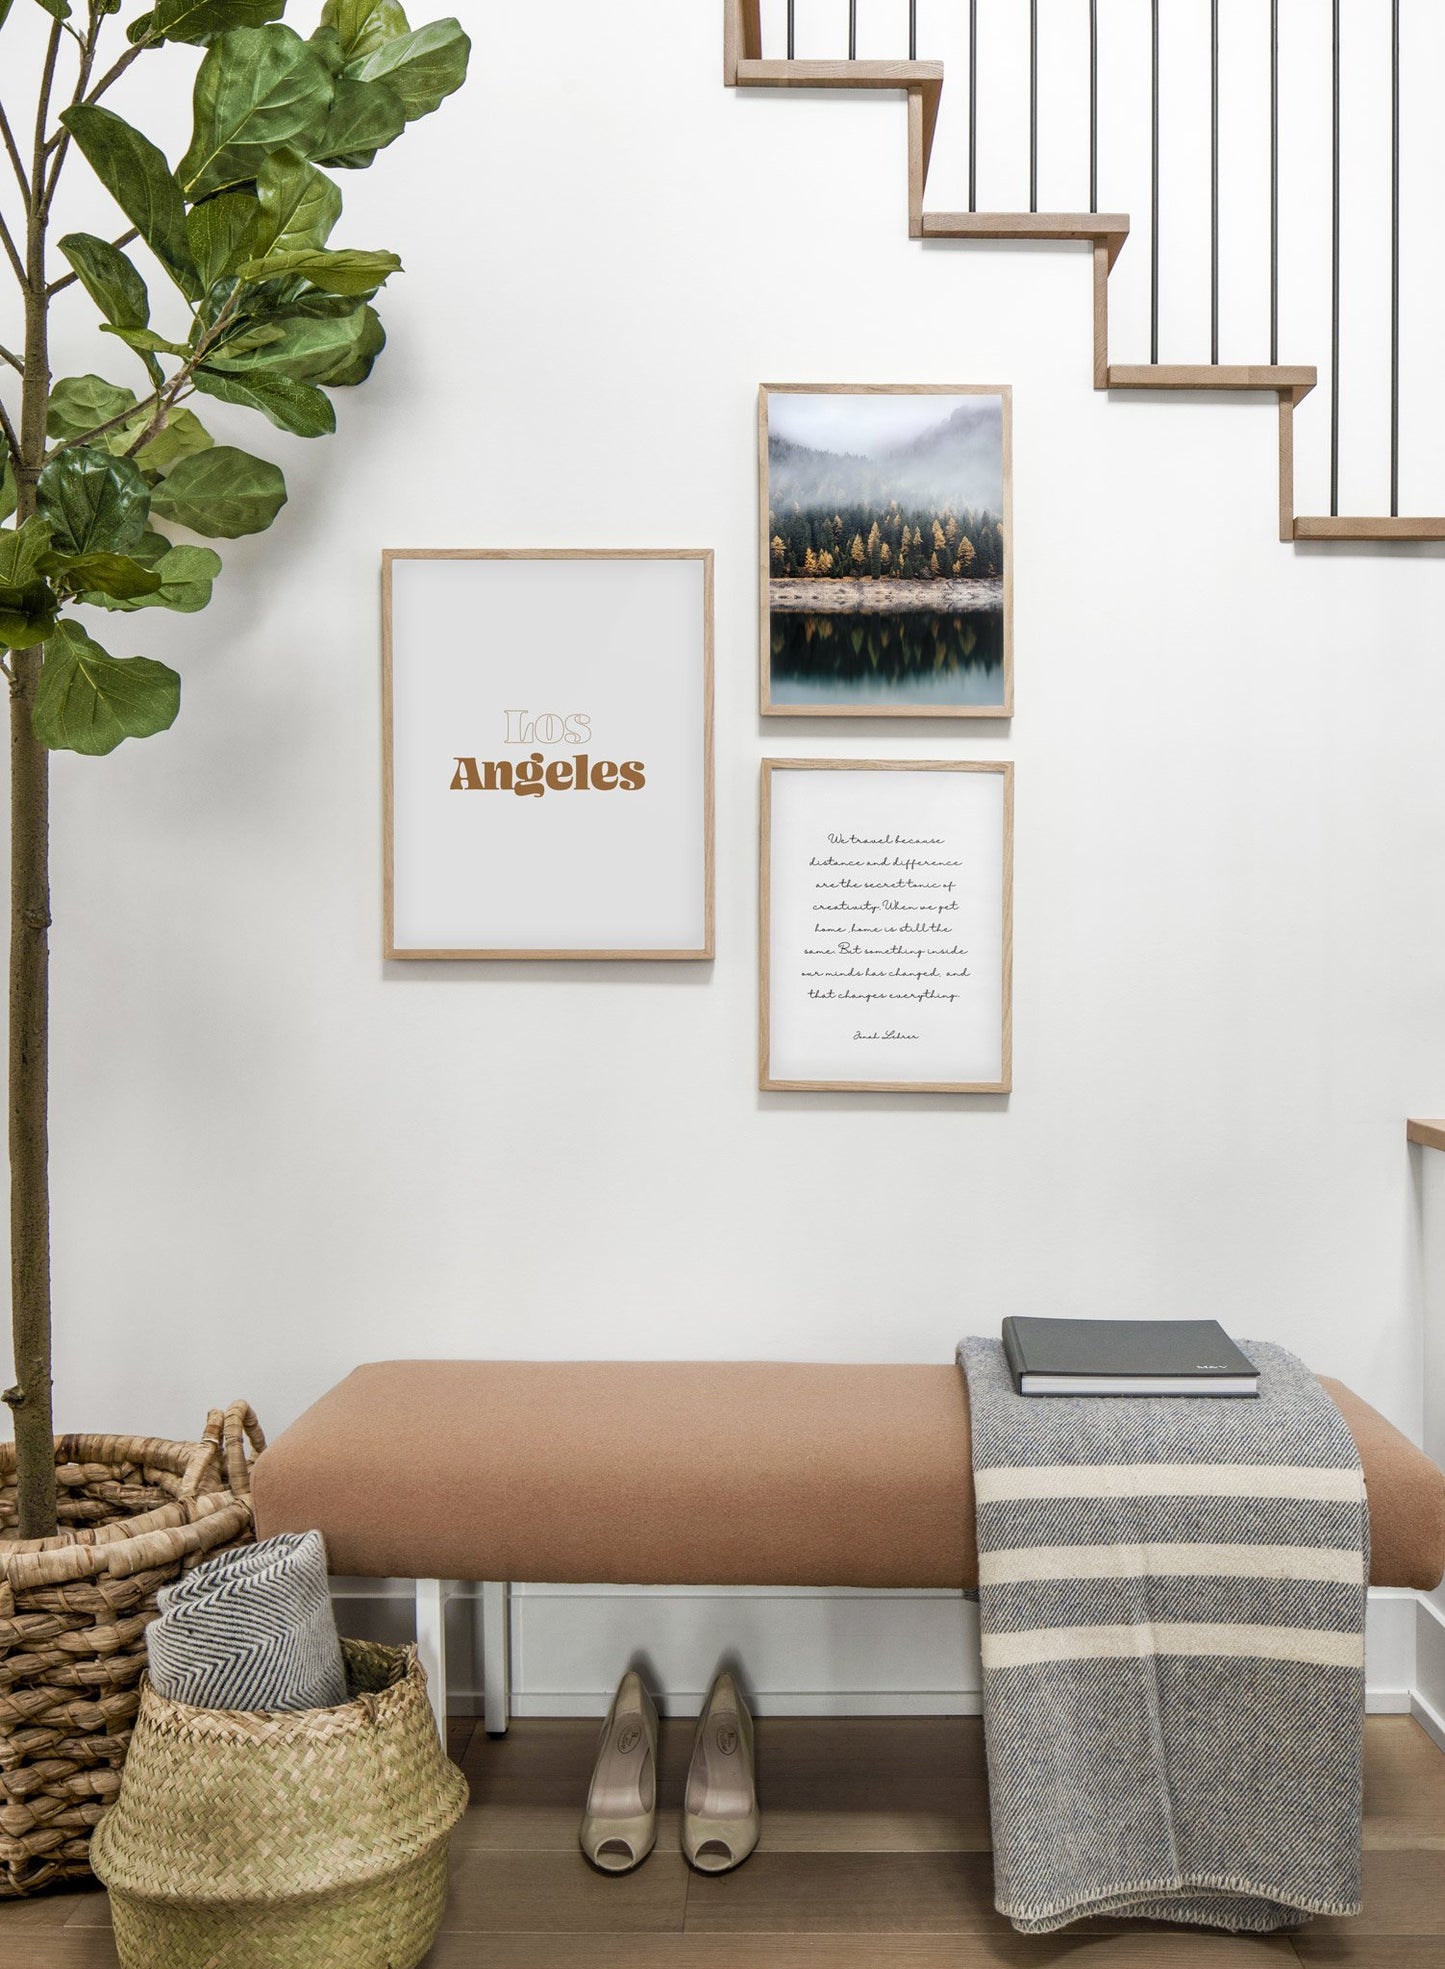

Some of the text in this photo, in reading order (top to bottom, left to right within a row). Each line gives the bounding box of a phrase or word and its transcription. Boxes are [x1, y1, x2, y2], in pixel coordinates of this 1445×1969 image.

[449, 752, 646, 798] Angeles
[827, 832, 944, 845] We travel because
[809, 856, 962, 871] distance and difference
[839, 878, 862, 889] the
[864, 878, 906, 889] secret
[906, 878, 941, 889] tonic
[943, 880, 956, 893] of
[882, 899, 918, 911] When
[938, 900, 959, 915] get
[899, 922, 930, 933] still
[930, 922, 952, 933] the
[864, 944, 925, 959] something
[927, 944, 968, 955] inside
[826, 967, 864, 977] minds
[865, 967, 887, 977] has
[946, 967, 970, 977] and
[808, 988, 836, 999] that
[838, 989, 887, 1003] changes
